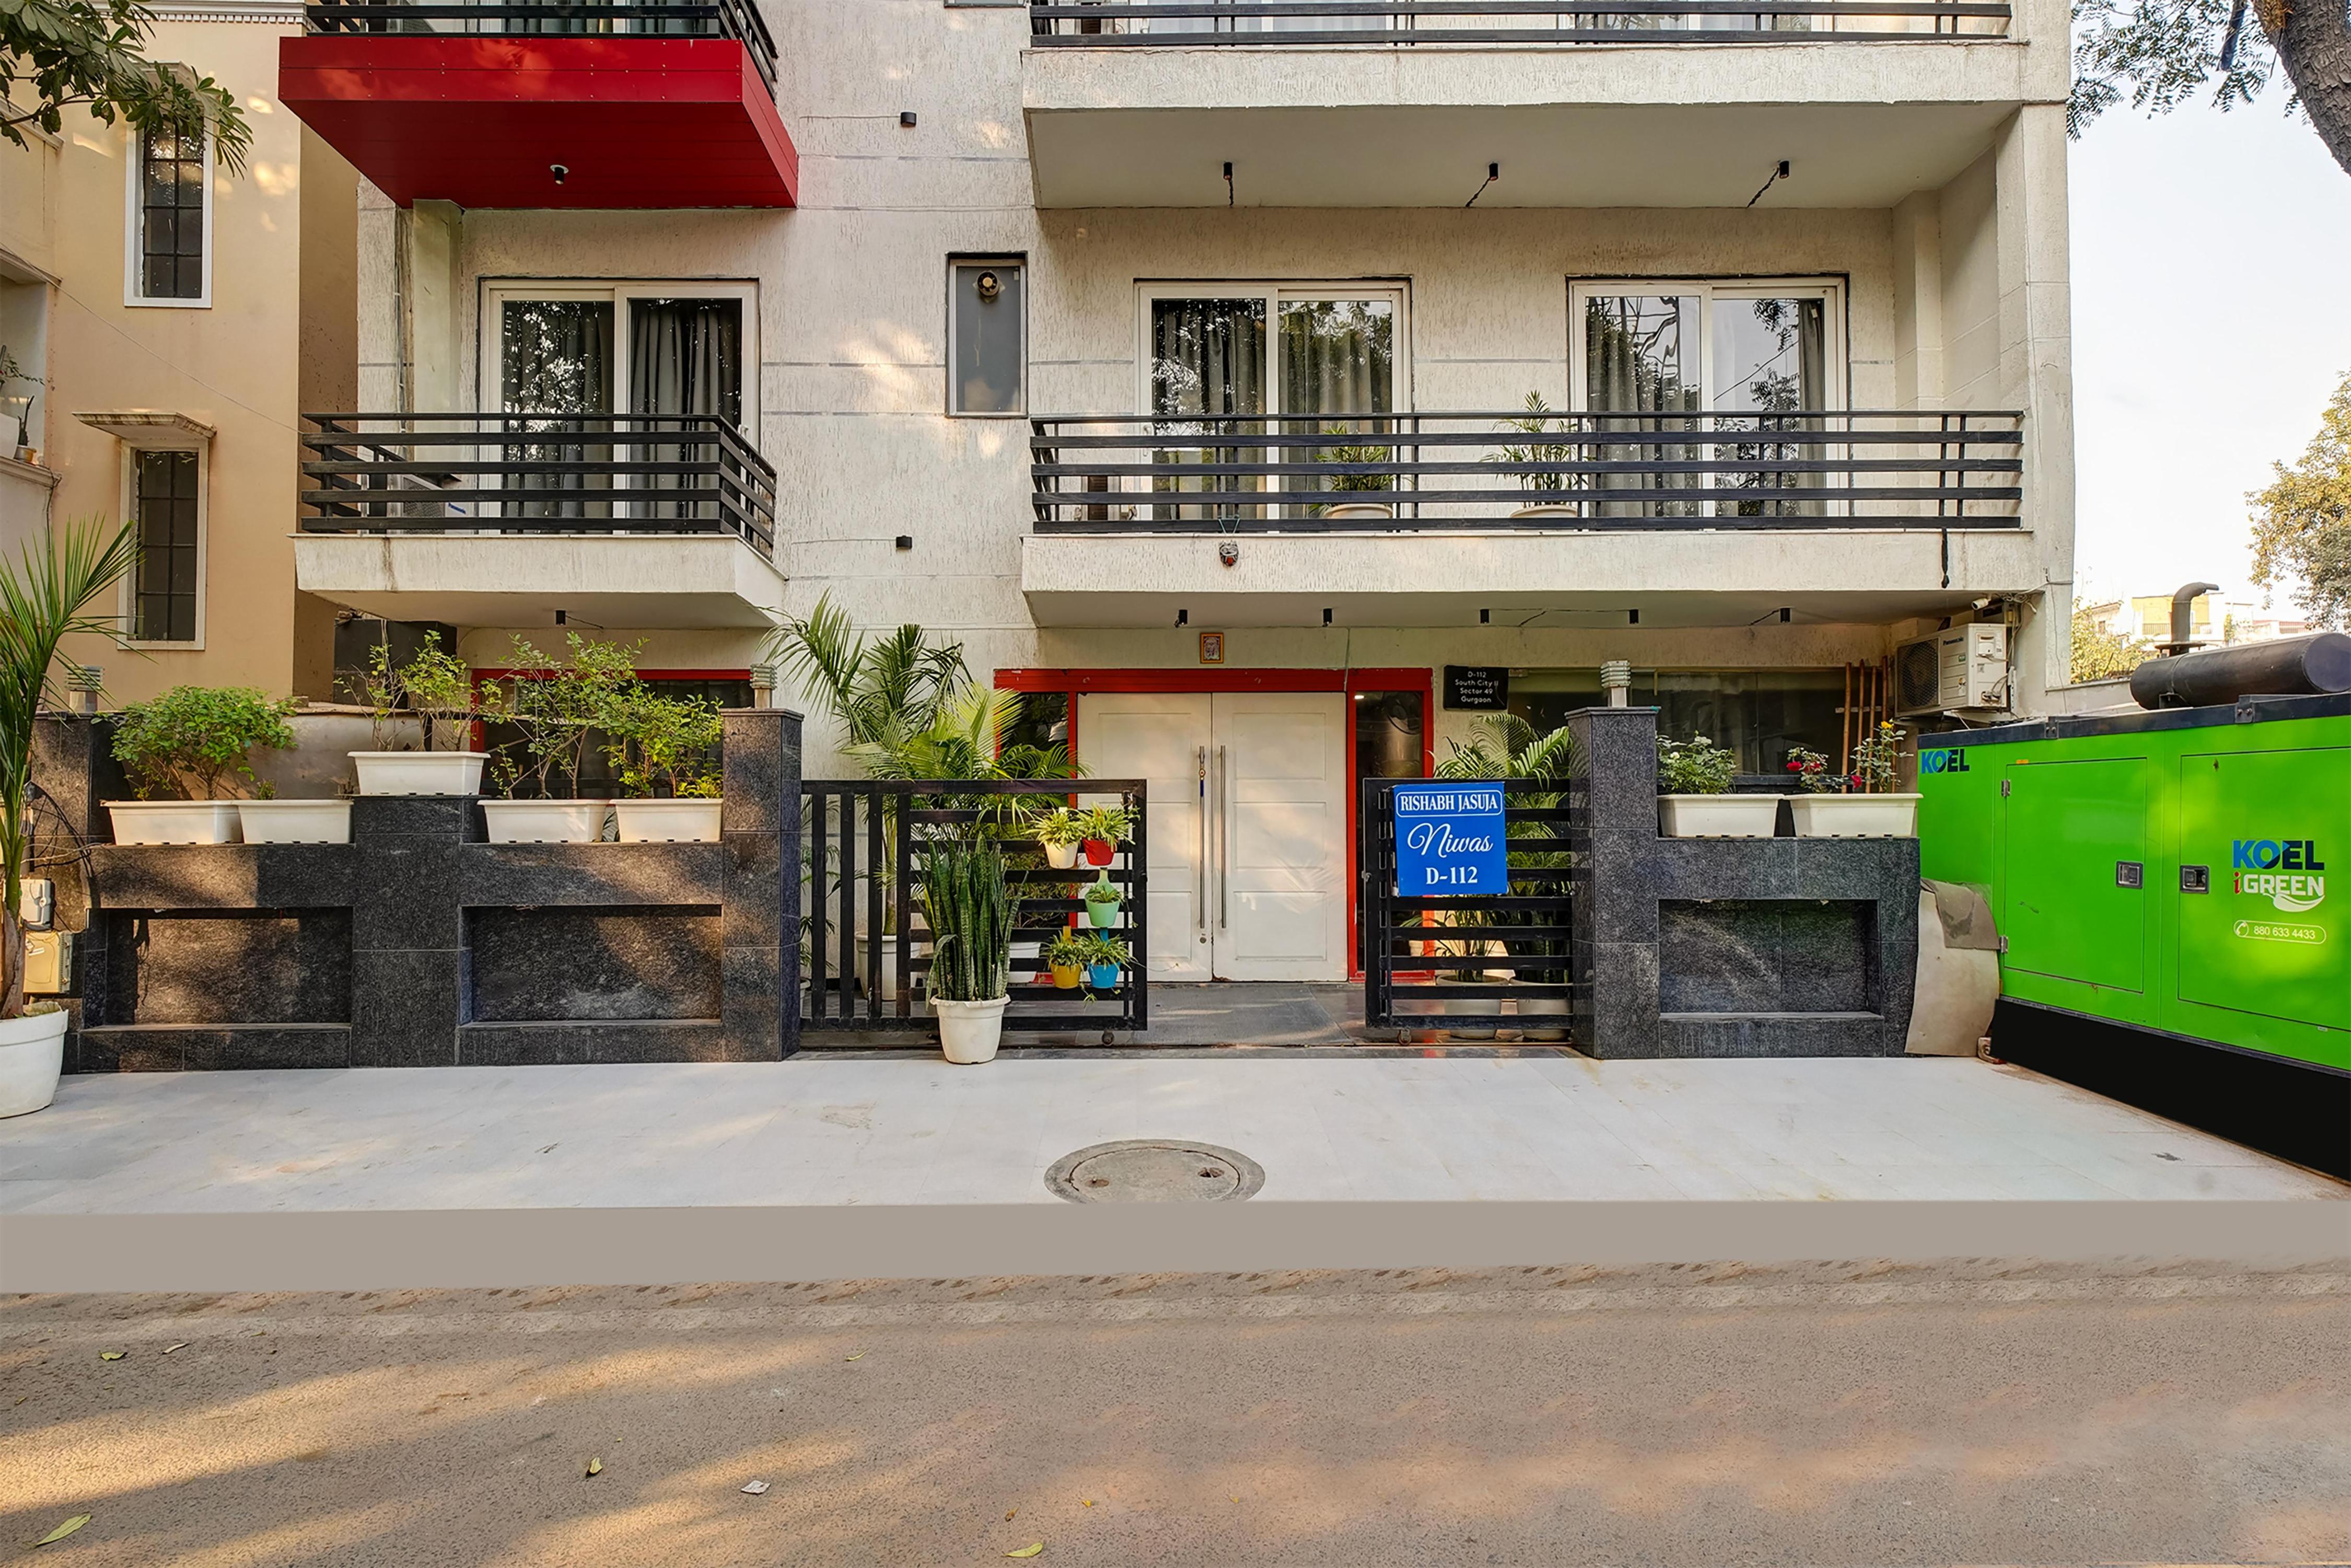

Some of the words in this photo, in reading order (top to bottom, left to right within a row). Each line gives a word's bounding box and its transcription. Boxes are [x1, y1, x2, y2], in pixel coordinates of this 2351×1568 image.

[1921, 749, 1970, 774] KOEL
[1400, 795, 1454, 811] RISHABH
[1458, 794, 1498, 812] JASUJA
[1407, 822, 1493, 858] Niwas
[2232, 840, 2324, 870] KOEL
[1426, 866, 1478, 885] D-112
[2253, 925, 2270, 935] 880
[2273, 927, 2289, 937] 633
[2291, 930, 2316, 939] 4433
